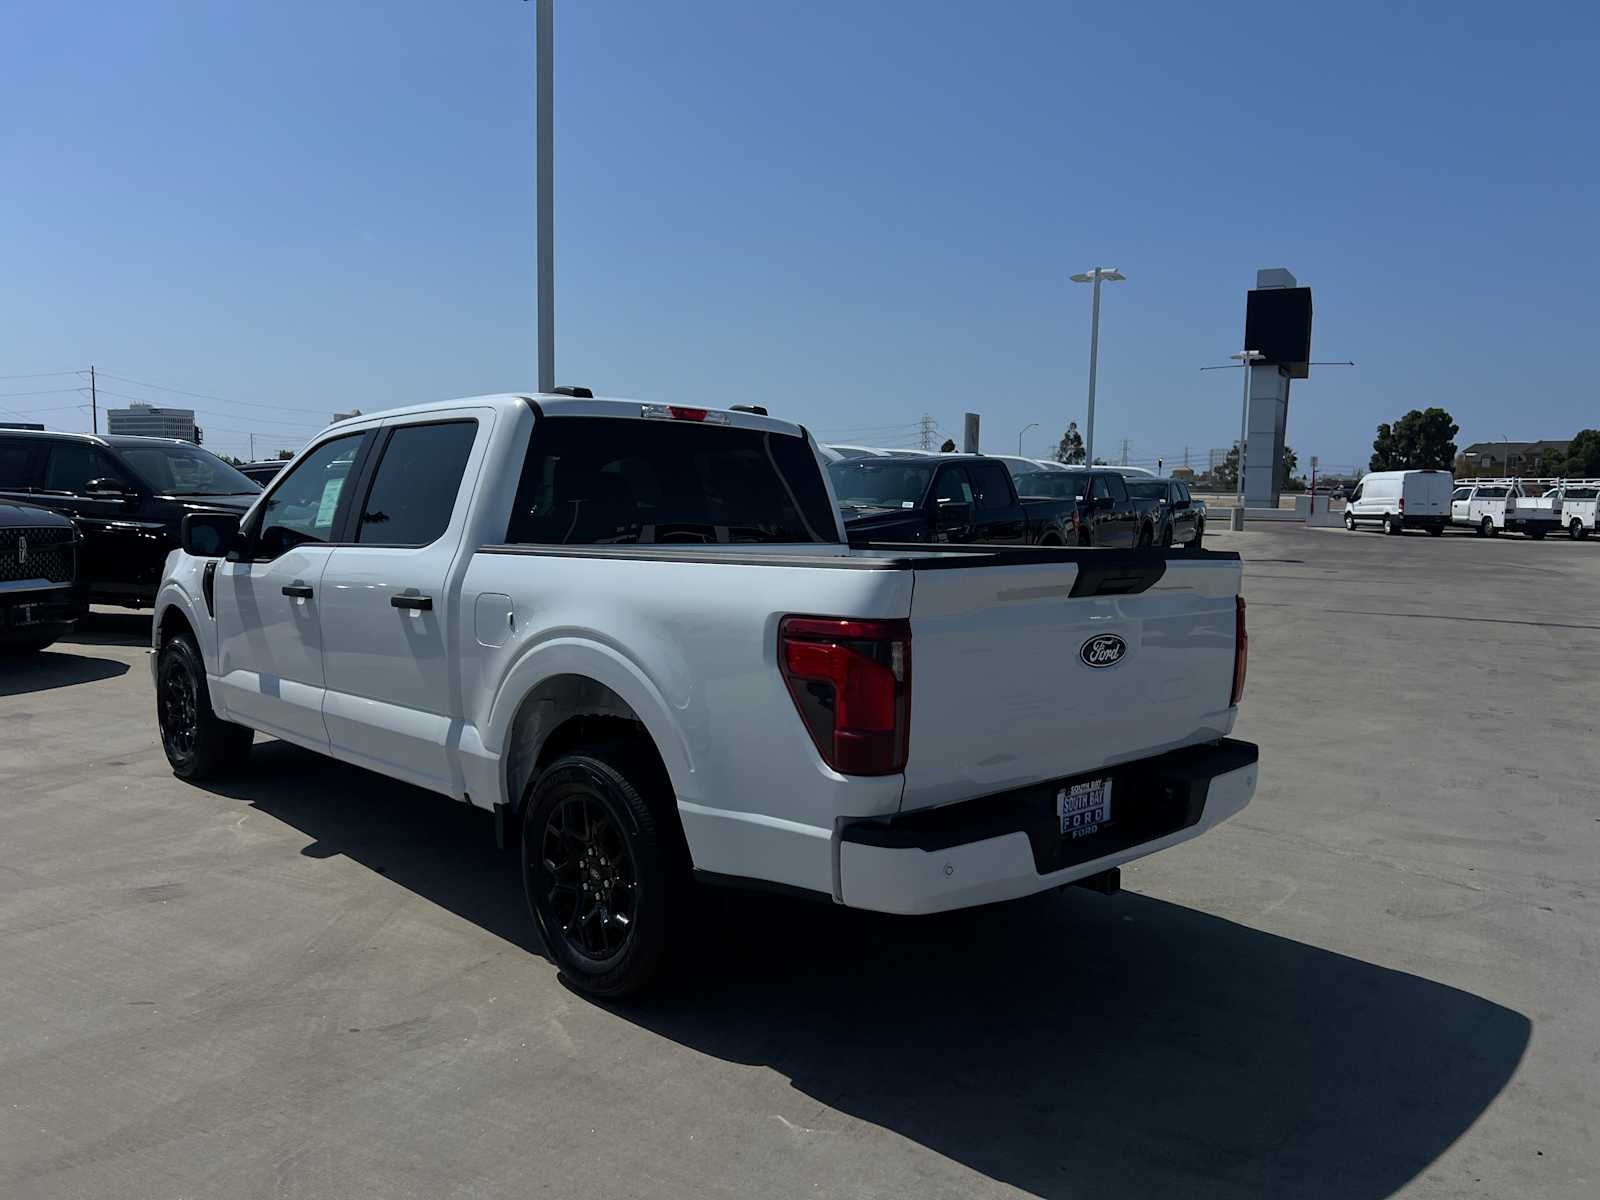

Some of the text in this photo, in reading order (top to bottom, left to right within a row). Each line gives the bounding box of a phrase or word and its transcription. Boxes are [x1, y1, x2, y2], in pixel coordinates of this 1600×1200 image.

[1089, 639, 1120, 662] Ford
[1064, 790, 1104, 811] SOUTH BAY
[1064, 809, 1102, 832] FORD
[1072, 825, 1098, 839] FORD
